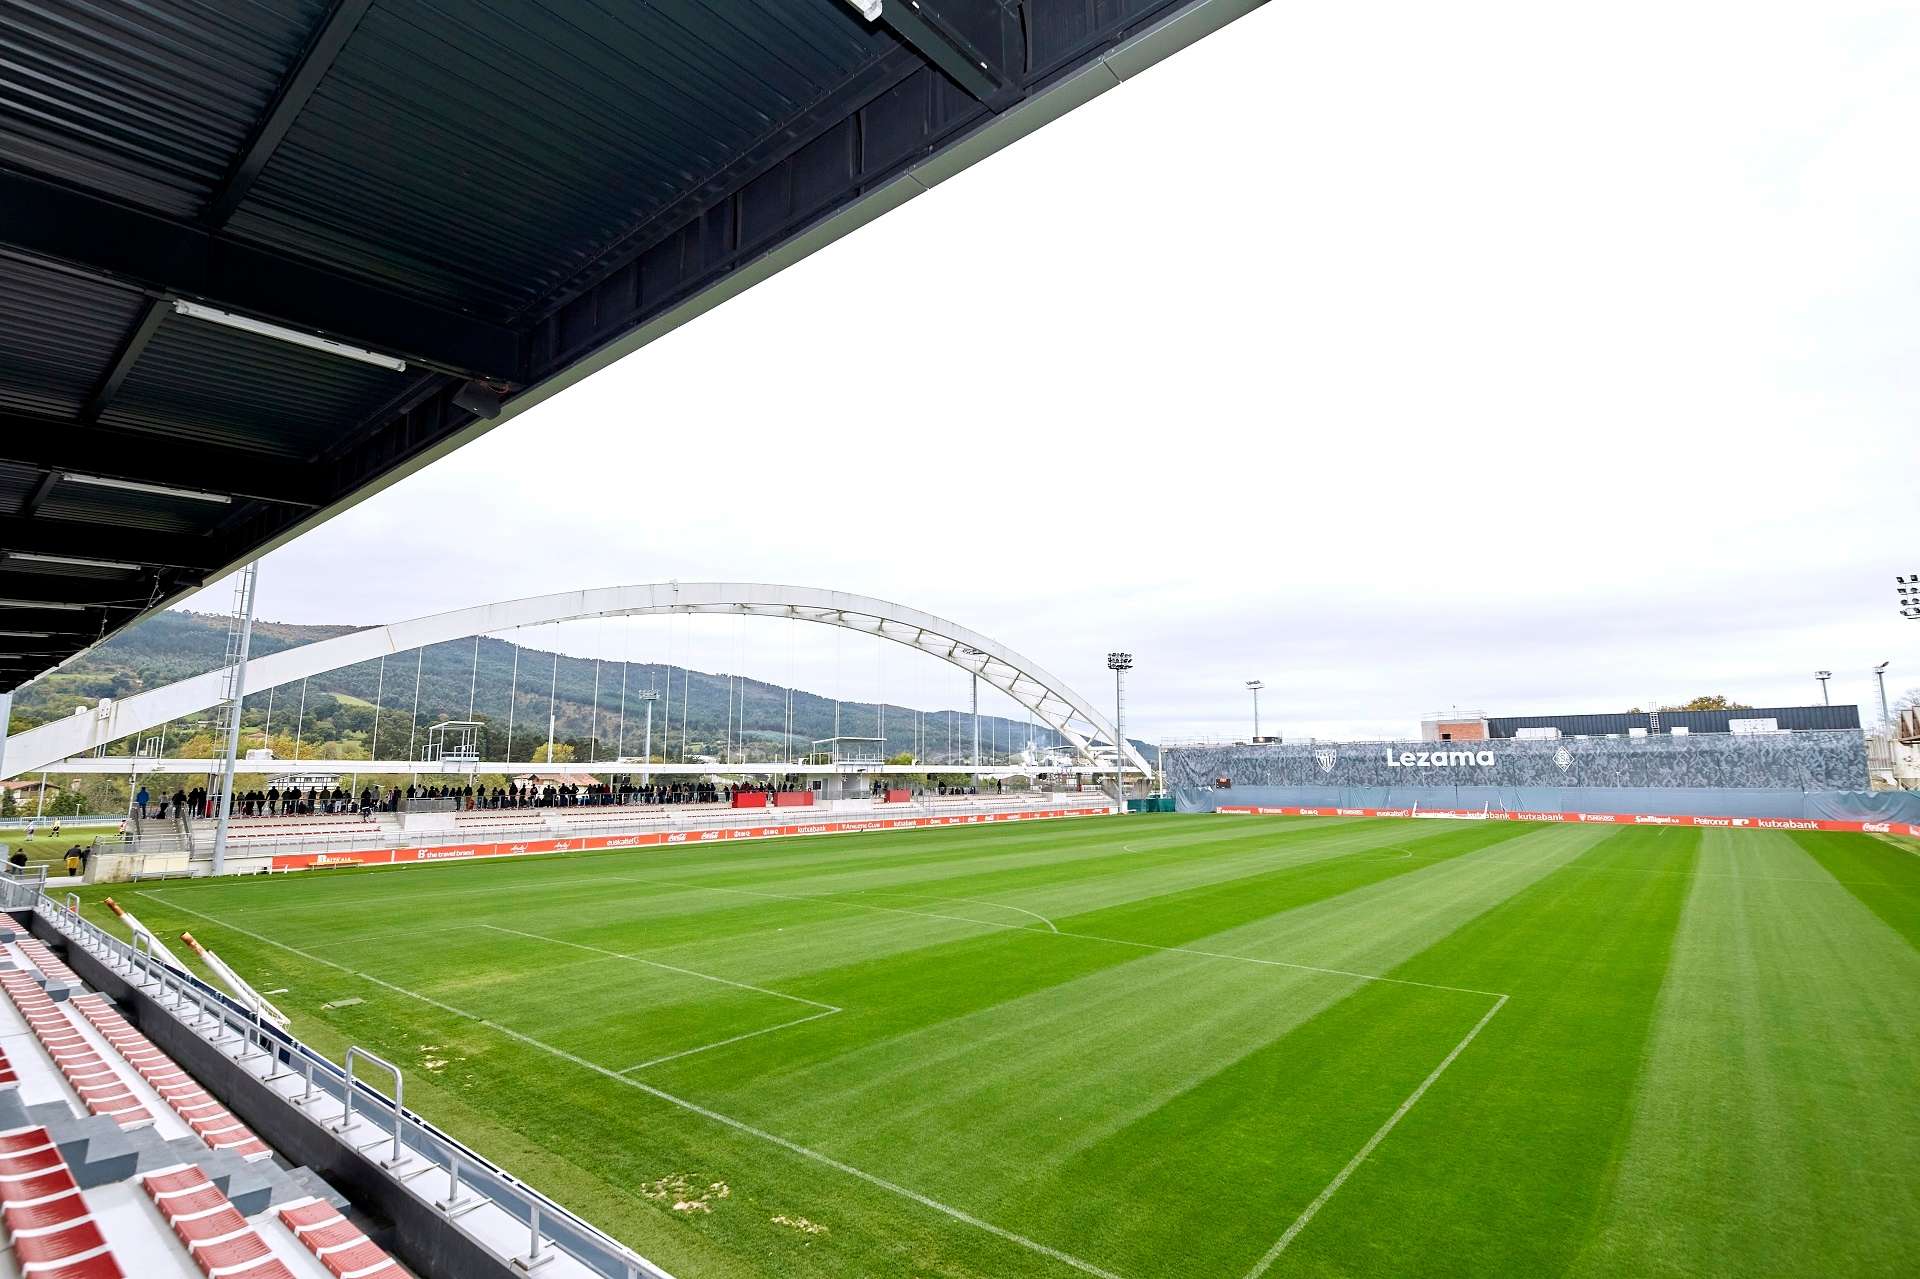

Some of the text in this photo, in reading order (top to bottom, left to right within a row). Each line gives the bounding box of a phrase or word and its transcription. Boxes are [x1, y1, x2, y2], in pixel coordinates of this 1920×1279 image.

[1386, 748, 1495, 767] Lezama
[1518, 813, 1564, 821] kutxabank
[1693, 817, 1729, 825] Petronor
[1758, 819, 1819, 829] kutxabank
[797, 825, 826, 833] kutxabank
[438, 849, 455, 858] travel
